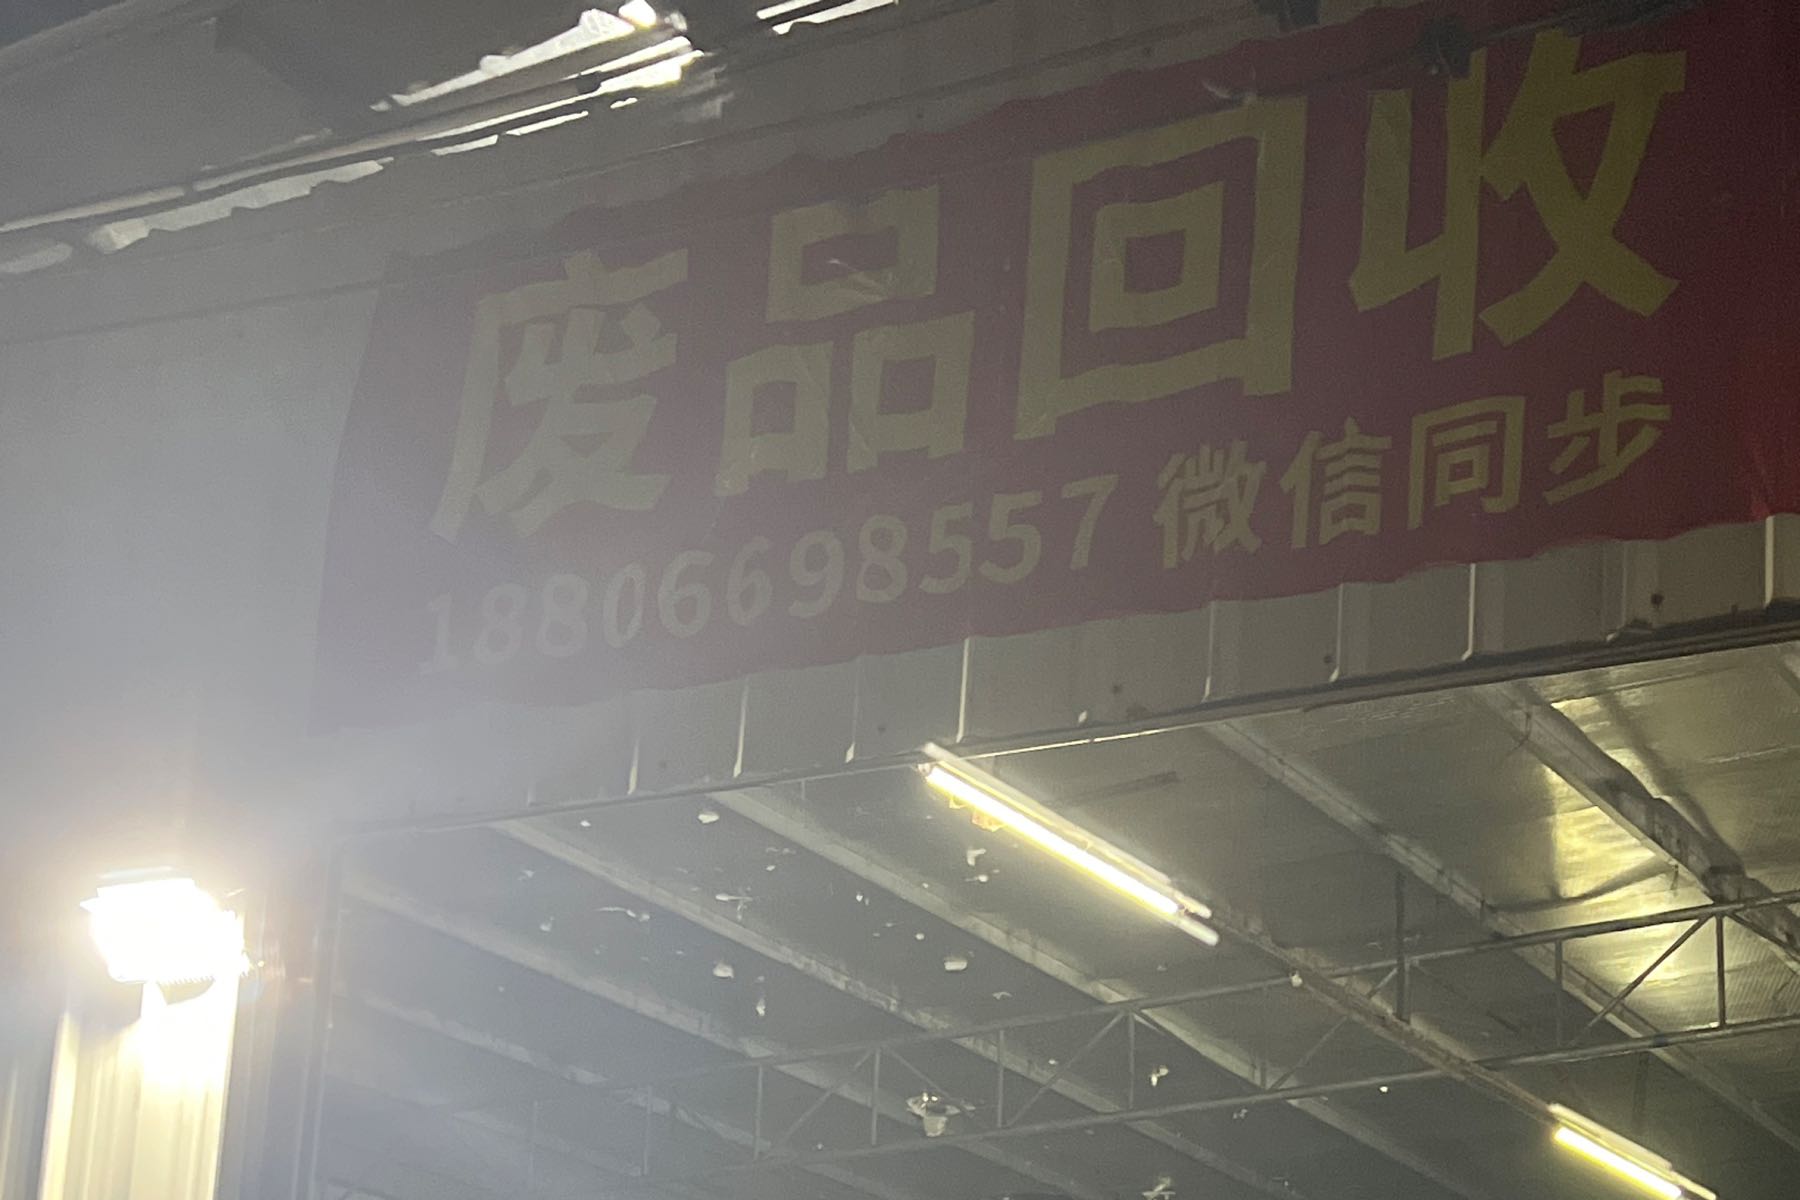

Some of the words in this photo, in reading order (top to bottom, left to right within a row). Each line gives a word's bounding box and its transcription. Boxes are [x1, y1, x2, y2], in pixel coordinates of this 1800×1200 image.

[428, 26, 1687, 542] 废品回收
[418, 473, 1118, 676] 18806698557
[1153, 369, 1671, 569] 微信同步
